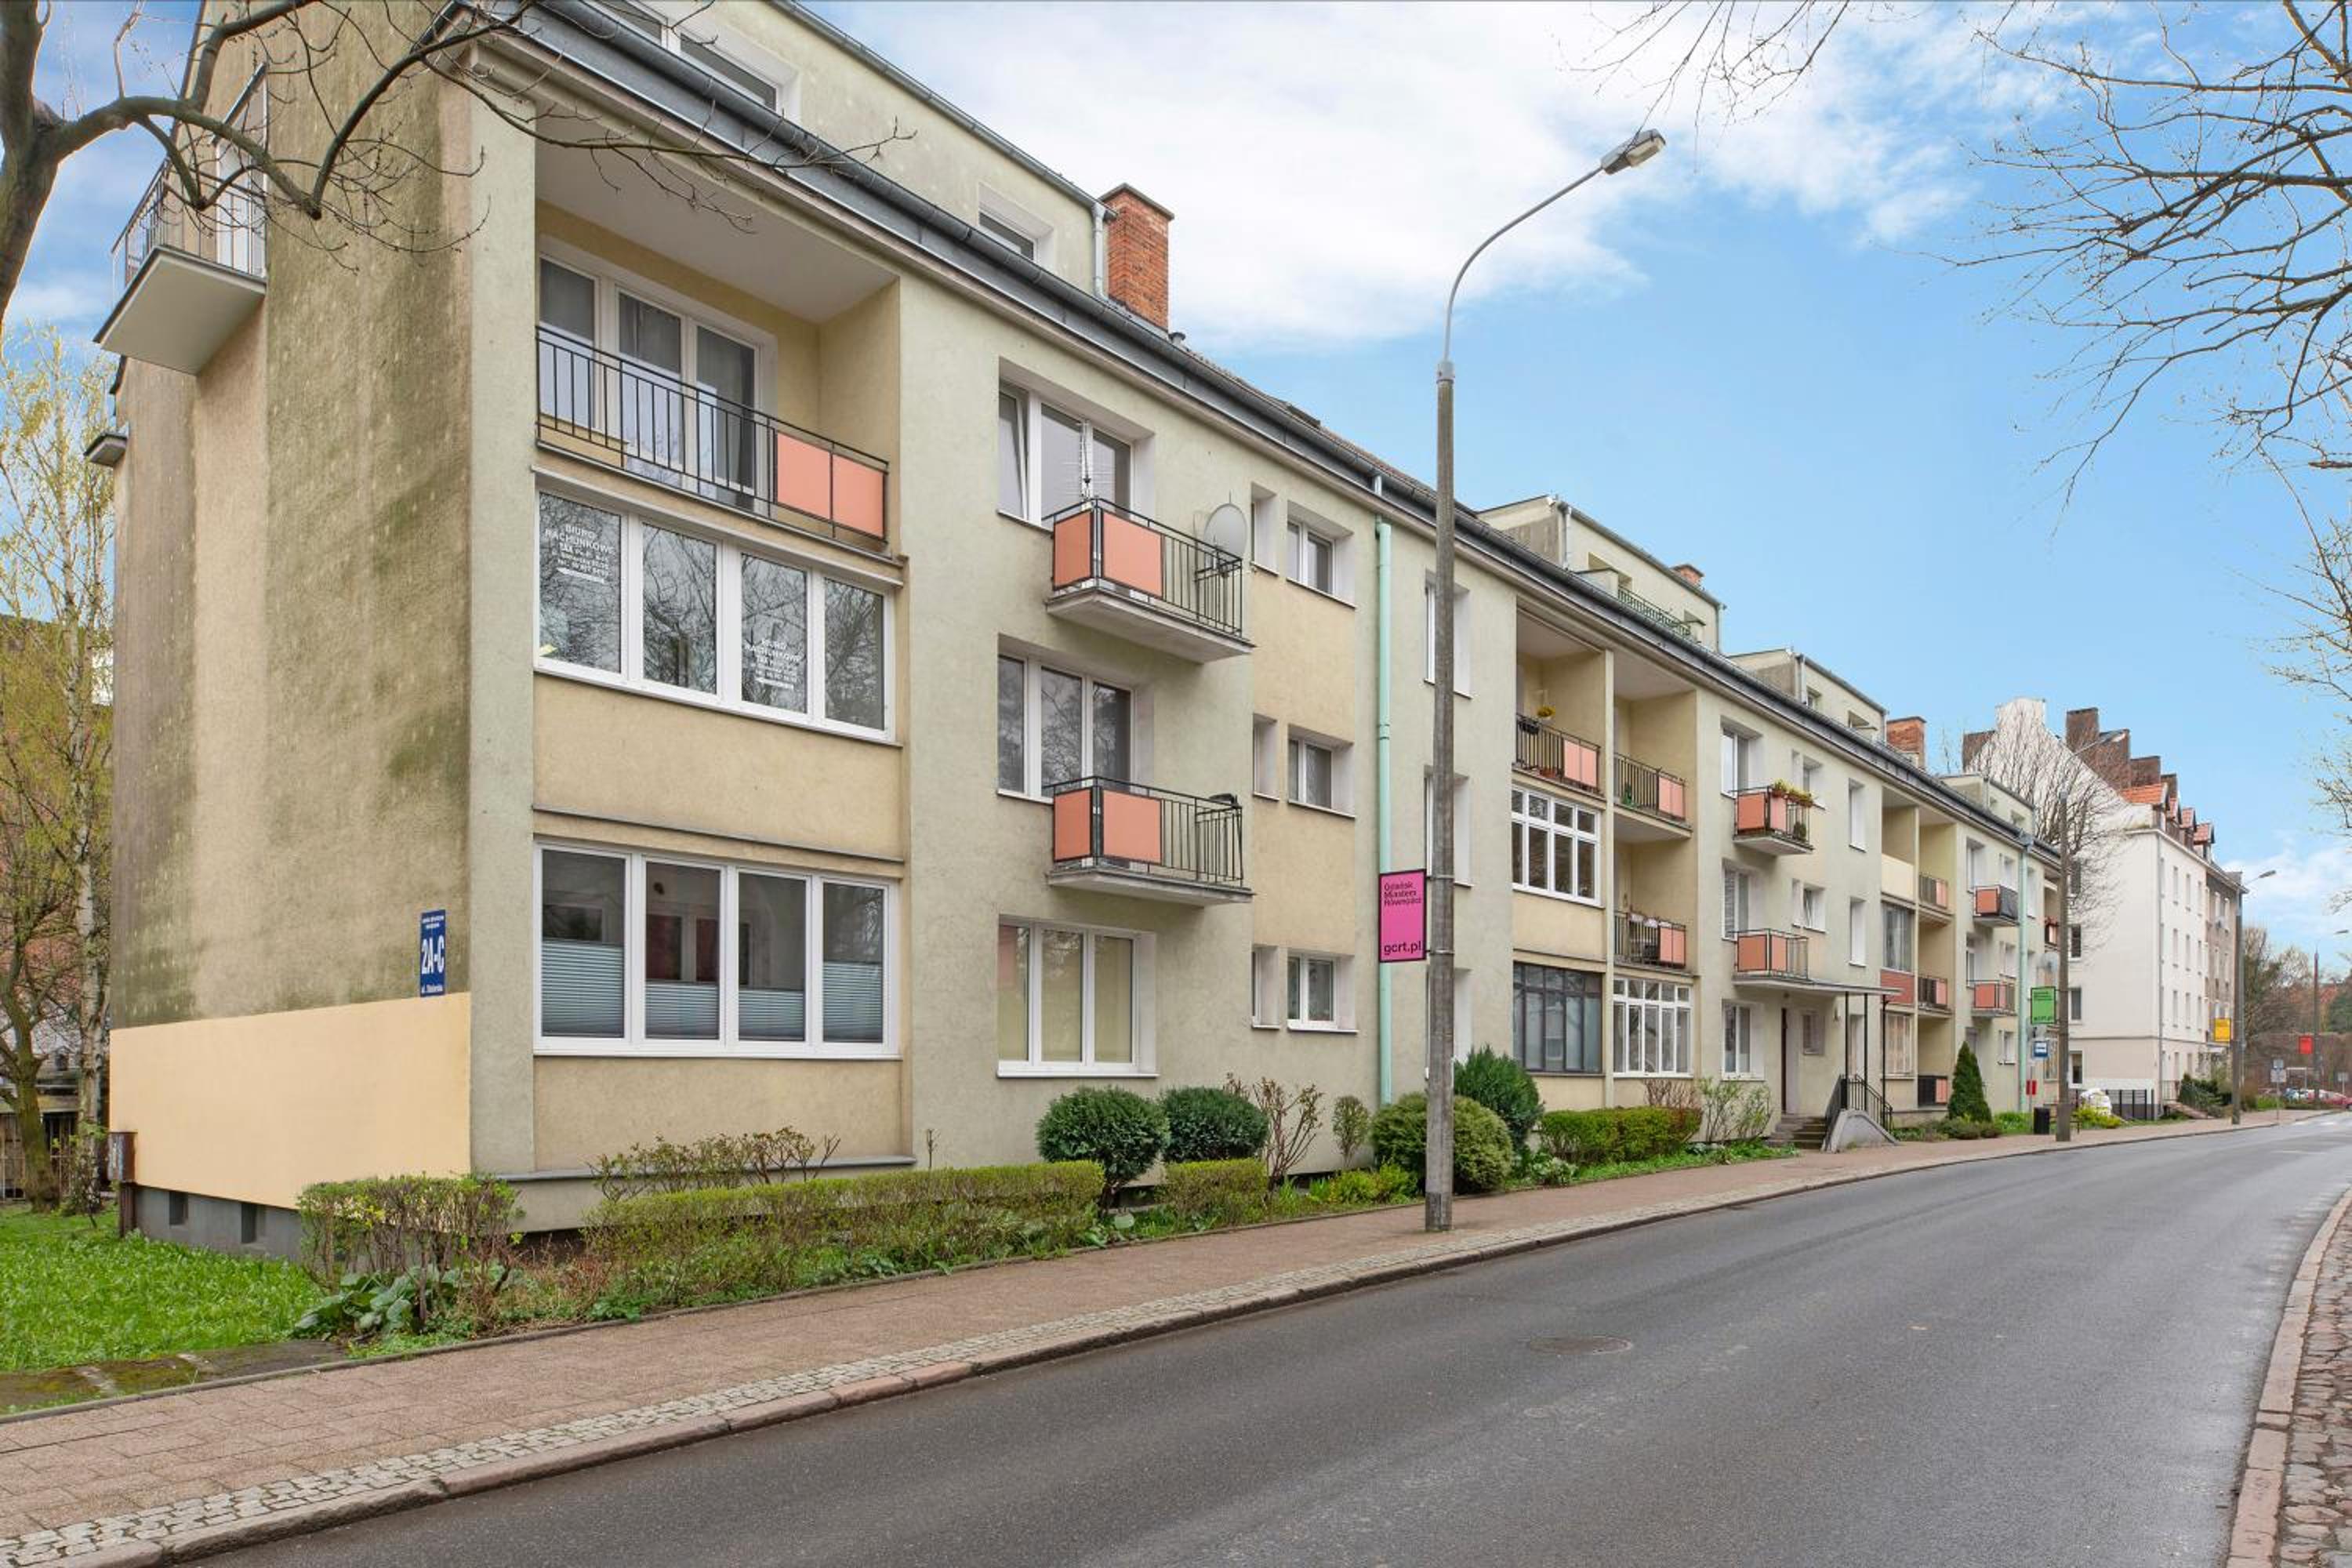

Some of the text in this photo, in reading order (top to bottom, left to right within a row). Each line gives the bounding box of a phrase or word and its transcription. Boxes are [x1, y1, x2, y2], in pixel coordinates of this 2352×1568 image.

[564, 524, 596, 539] BIURO
[421, 934, 445, 975] 2A-C
[1384, 940, 1422, 956] gcrt.pl
